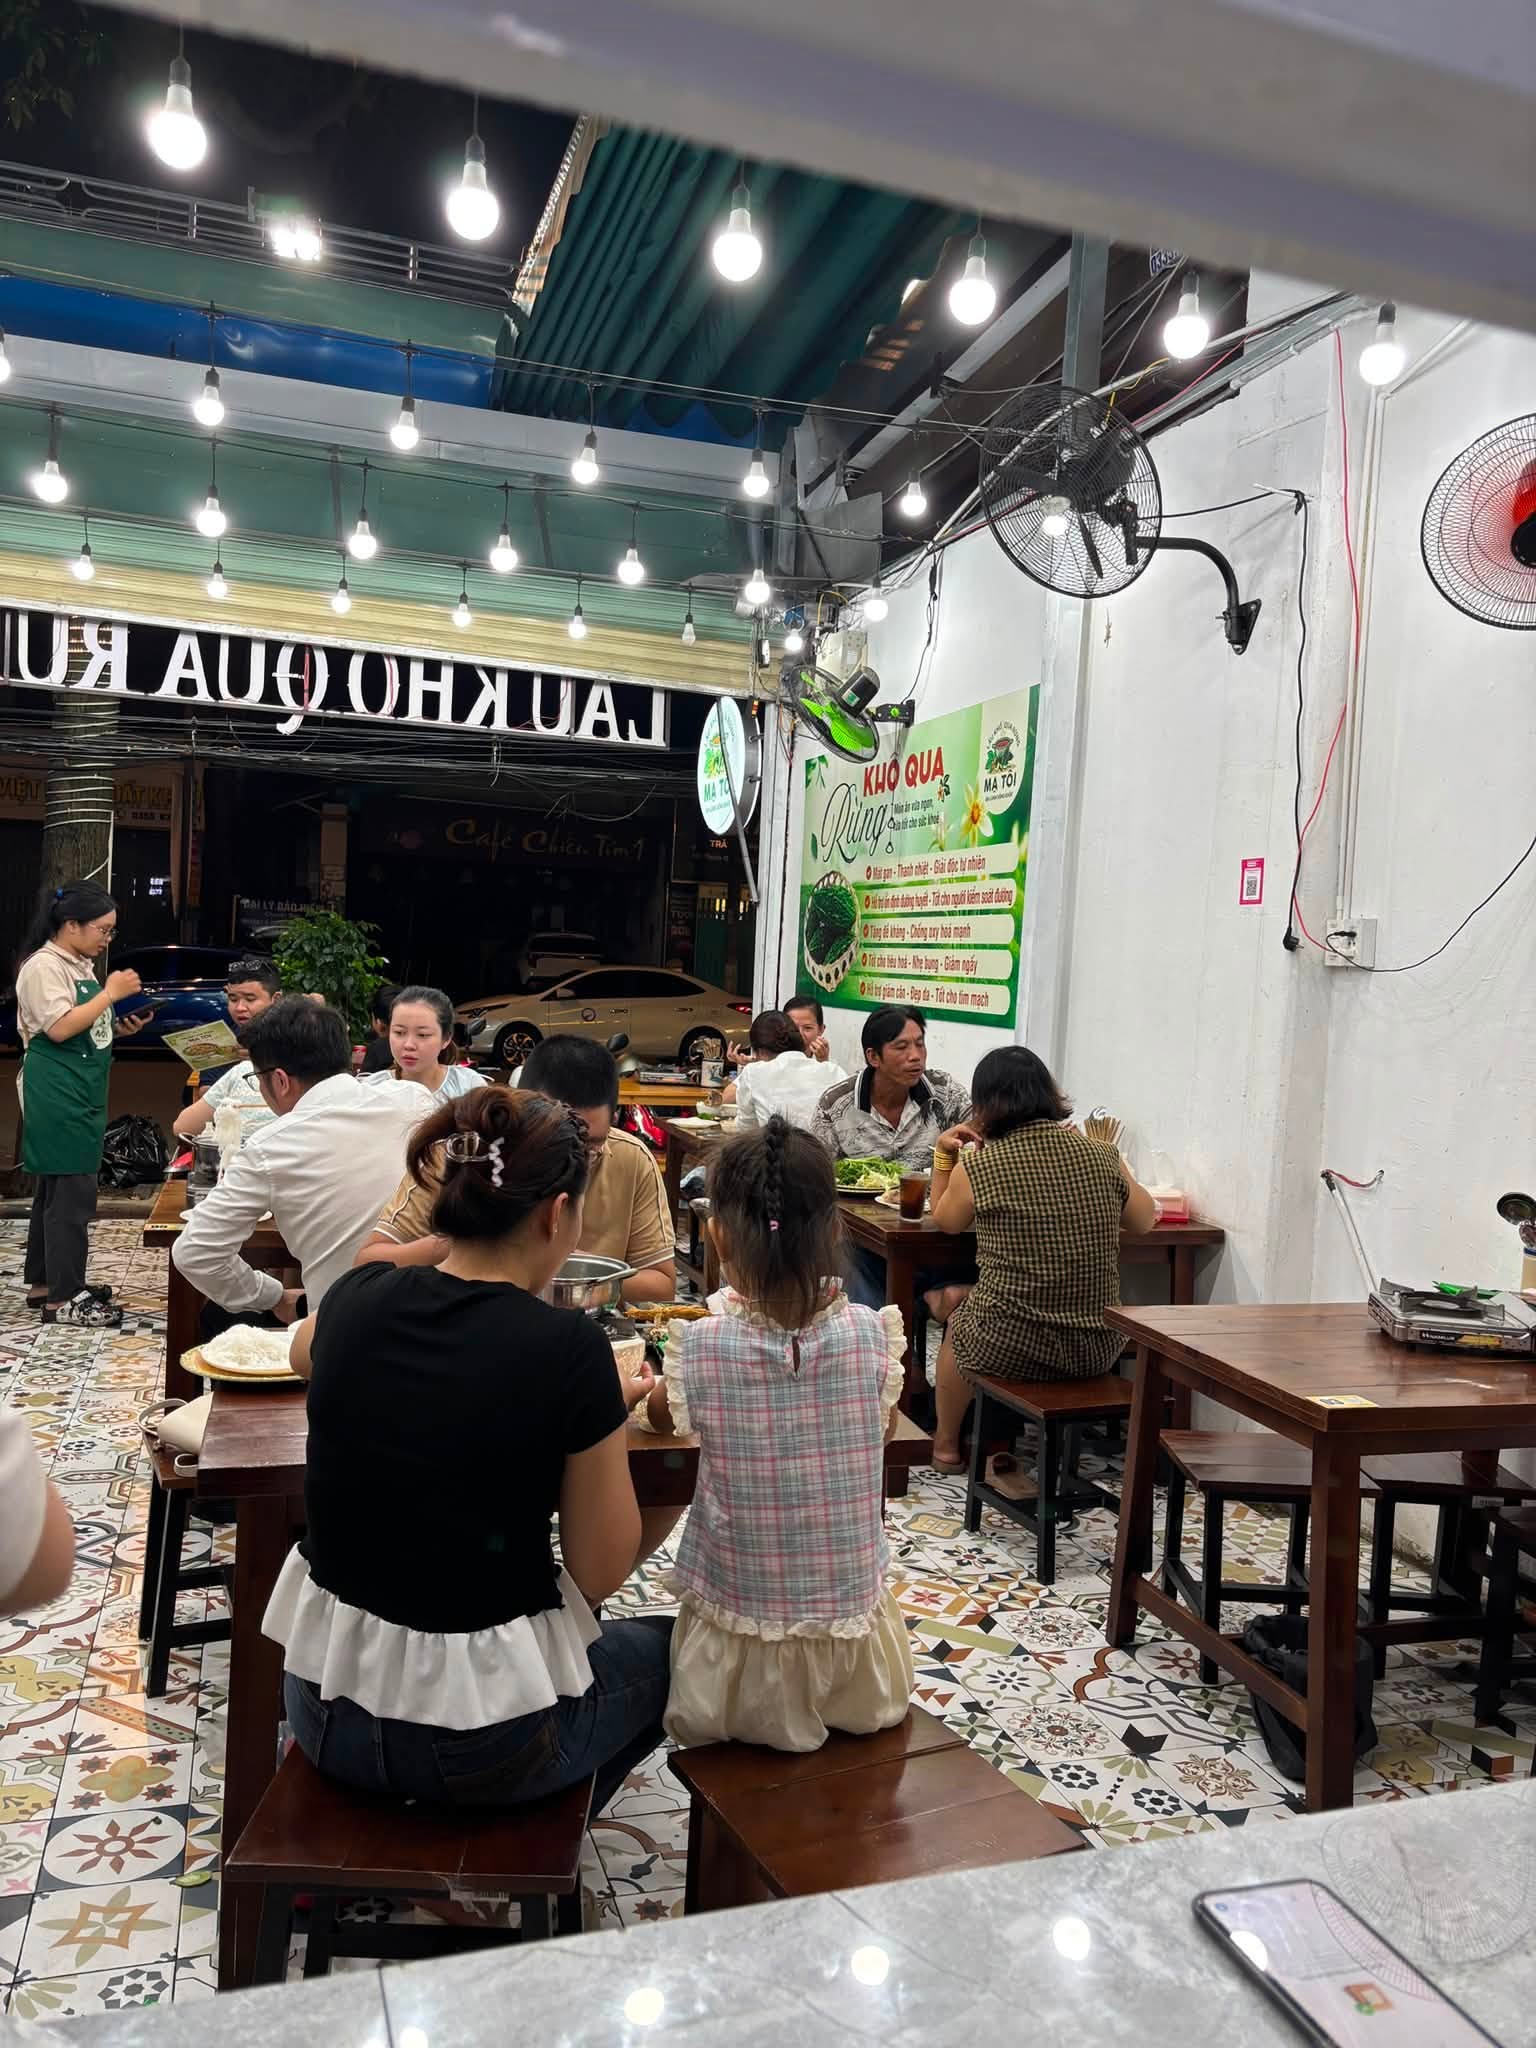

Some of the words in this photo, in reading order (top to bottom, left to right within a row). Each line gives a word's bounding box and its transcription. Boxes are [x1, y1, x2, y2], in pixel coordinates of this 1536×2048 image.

[905, 746, 945, 788] QUA
[898, 863, 914, 878] Thanh
[946, 988, 957, 1004] cho
